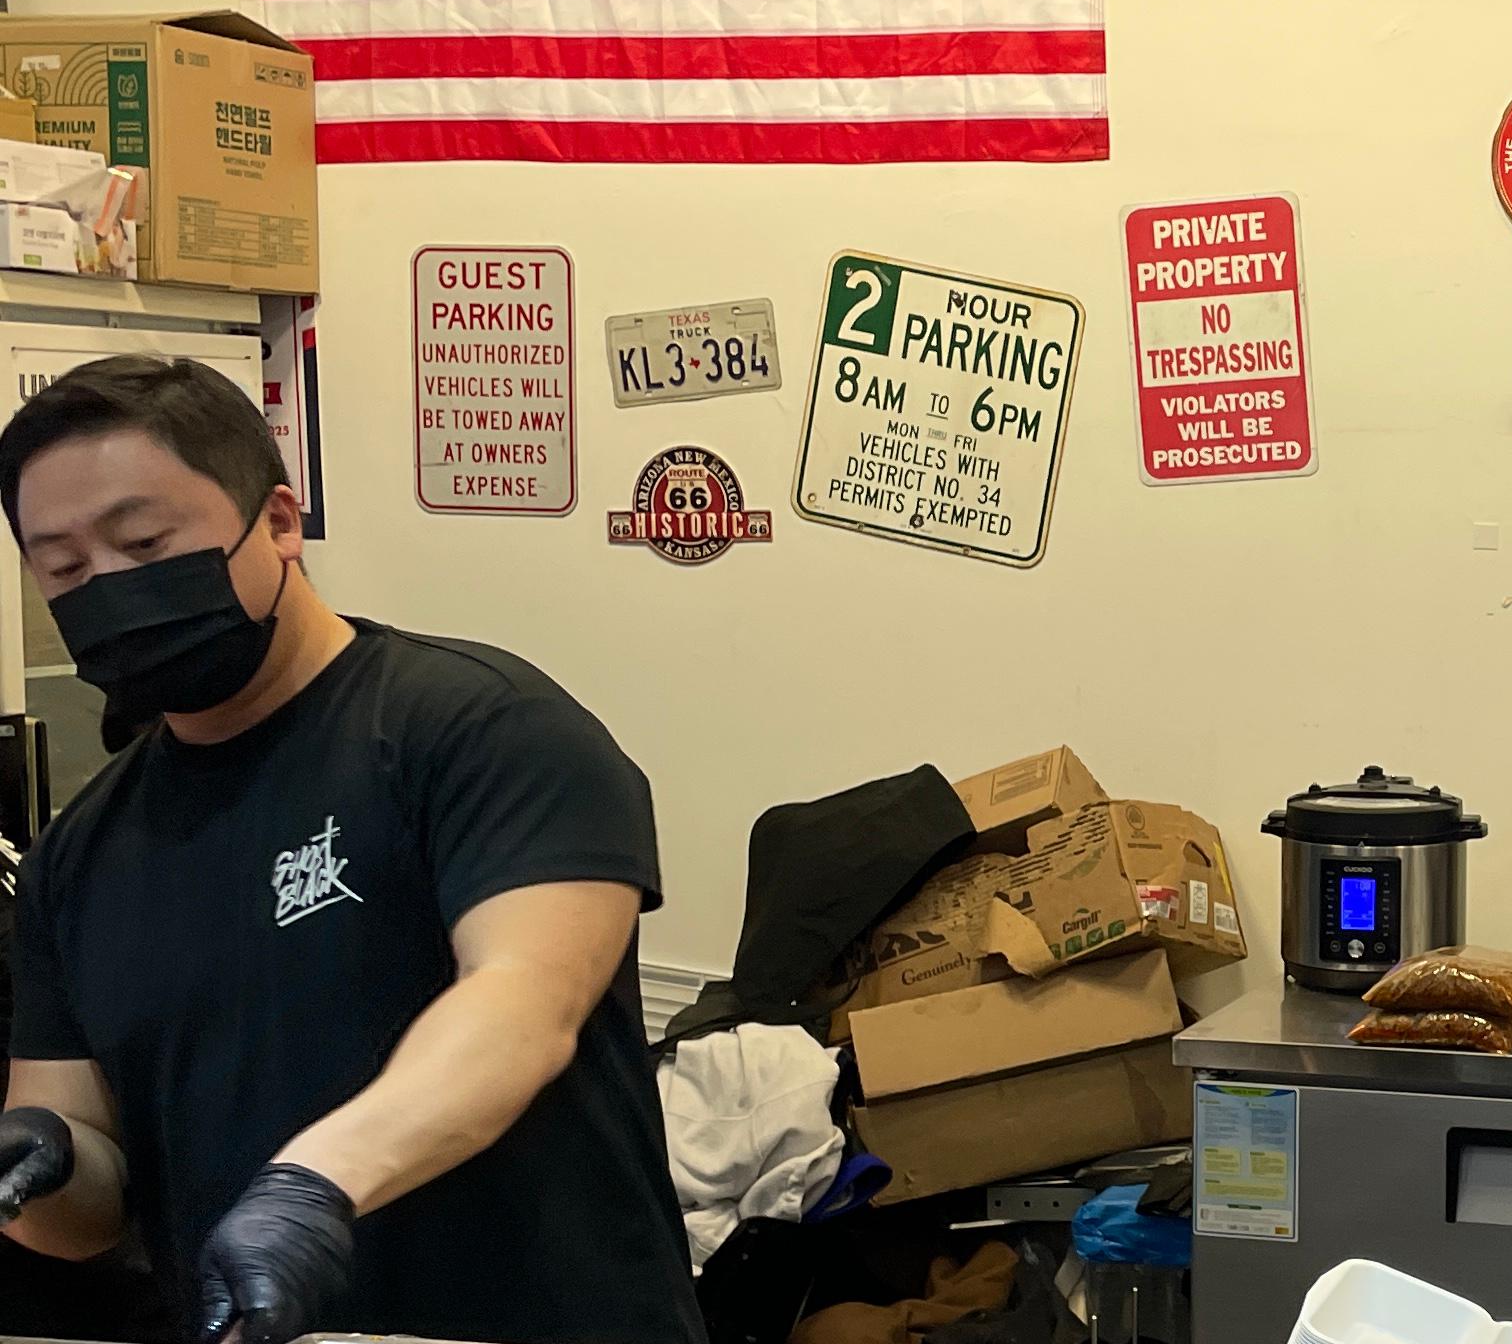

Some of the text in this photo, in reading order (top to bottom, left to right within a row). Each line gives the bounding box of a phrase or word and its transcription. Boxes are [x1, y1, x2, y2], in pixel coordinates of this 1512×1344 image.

[36, 120, 96, 135] REMIUM
[214, 99, 272, 131] 천연펄프
[215, 125, 273, 157] 핸드타월
[1153, 212, 1267, 250] PRIVATE
[438, 261, 546, 290] GUEST
[1136, 251, 1287, 292] PROPERTY
[432, 303, 554, 332] PARKING
[668, 311, 711, 326] TEXAS
[837, 269, 884, 346] 2
[946, 289, 1033, 329] HOUR
[1201, 304, 1231, 335] NO
[669, 327, 712, 340] TRUCK
[422, 343, 565, 365] UNAUTHORIZED
[901, 313, 1064, 390] PARKING
[1147, 340, 1294, 380] TRESPASSING
[424, 376, 564, 398] VEHICLES WILL
[928, 393, 950, 416] TO
[1161, 390, 1286, 417] VIOLATORS
[423, 409, 566, 432] BE TOWED AWAY
[1178, 417, 1274, 441] WILL BE
[886, 419, 920, 439] MON
[953, 435, 978, 452] FRI
[443, 443, 548, 465] AT OWNERS
[860, 432, 1001, 481] VEHICLES WITH
[1153, 441, 1302, 470] PROSECUTED
[453, 476, 538, 498] EXPENSE
[636, 450, 741, 512] ARIZONA NEW MEXICO
[668, 468, 706, 479] ROUTE
[845, 456, 1002, 507] DISTRICT NO. 34
[669, 487, 710, 510] 66
[828, 479, 1012, 537] PERMITS EXEMPTED
[612, 523, 631, 536] 66
[635, 512, 744, 539] HISTORIC
[748, 524, 768, 536] 66
[663, 539, 719, 559] KANSAS
[1062, 912, 1101, 935] Cargill
[901, 952, 972, 986] Genuinely
